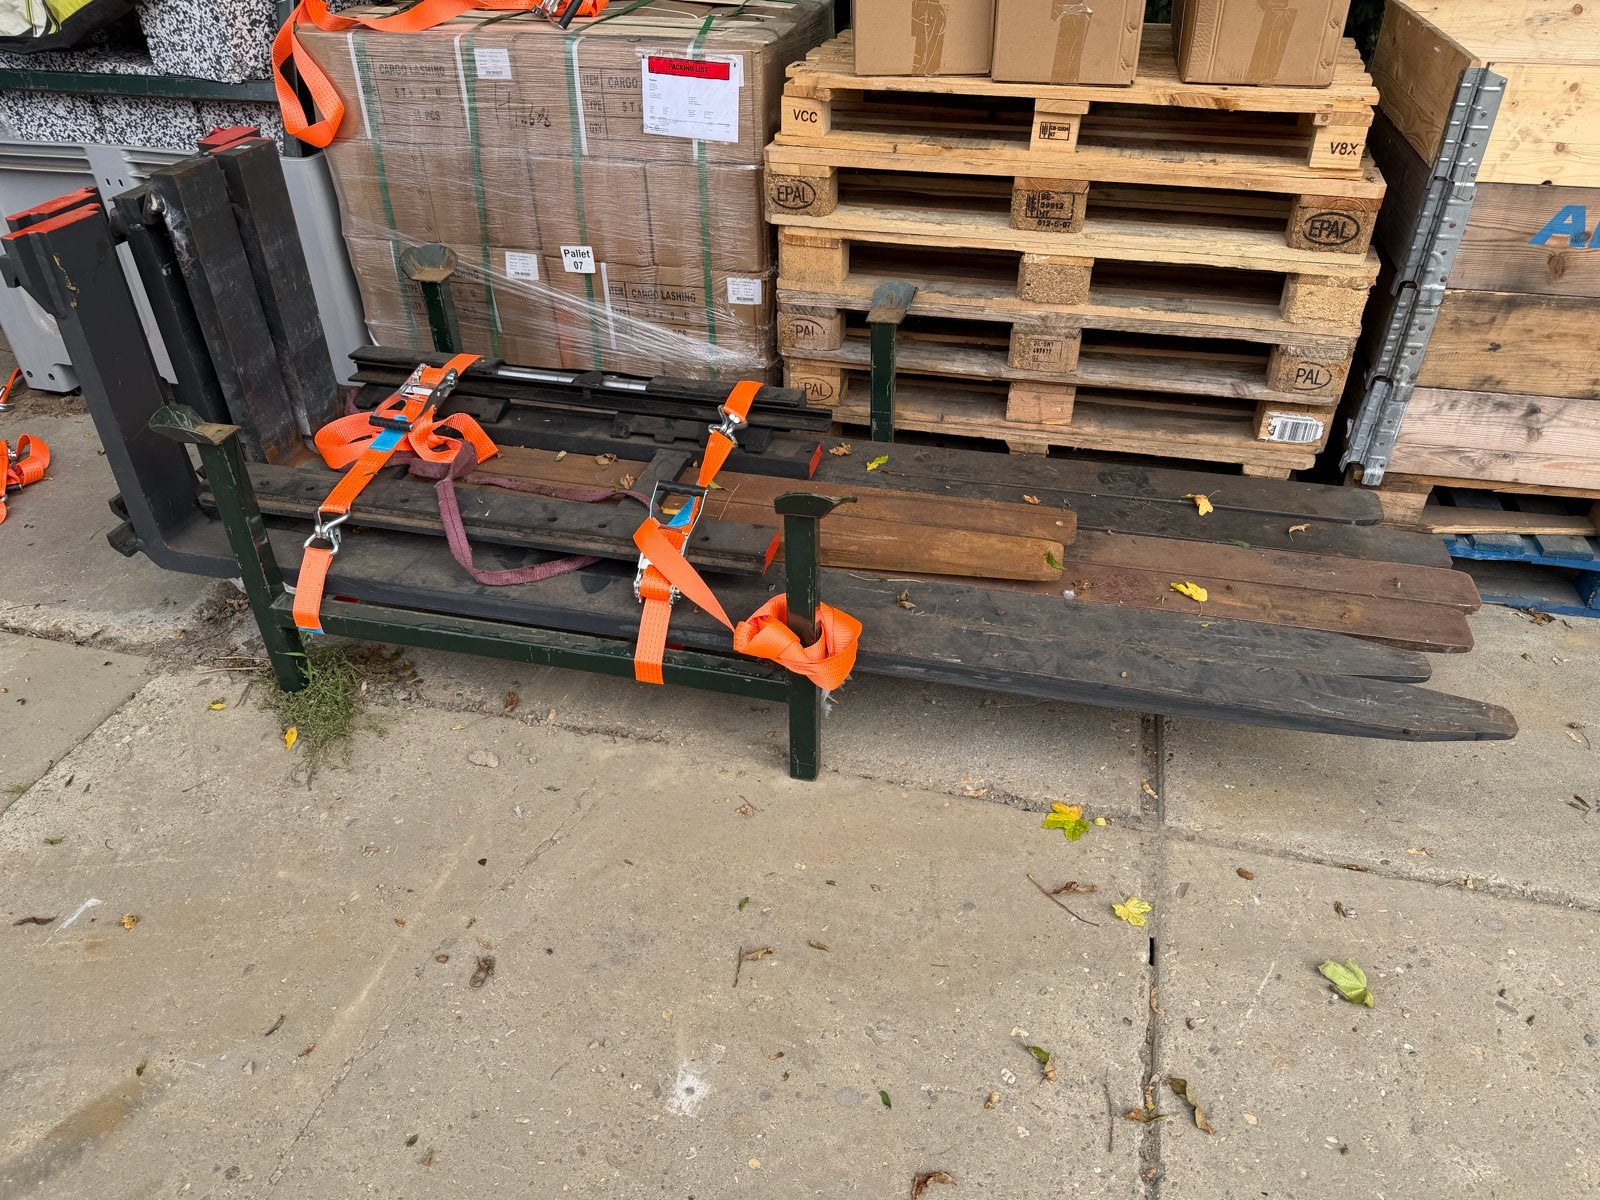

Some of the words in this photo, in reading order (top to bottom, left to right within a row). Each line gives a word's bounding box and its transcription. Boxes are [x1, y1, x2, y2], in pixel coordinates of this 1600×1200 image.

[379, 64, 407, 75] CARGO
[410, 65, 446, 76] LASHING
[668, 63, 694, 72] PACKING
[695, 65, 709, 73] LIST
[583, 75, 600, 86] ITEM
[608, 77, 638, 88] CARGO
[585, 100, 602, 111] TYPE
[793, 109, 818, 123] VCC
[1330, 141, 1359, 156] V8X
[777, 184, 810, 204] EPAL
[1308, 219, 1350, 240] EPAL
[564, 249, 591, 259] Pallet
[573, 261, 583, 270] 07
[631, 288, 659, 300] CARGO
[660, 289, 696, 303] LASHING
